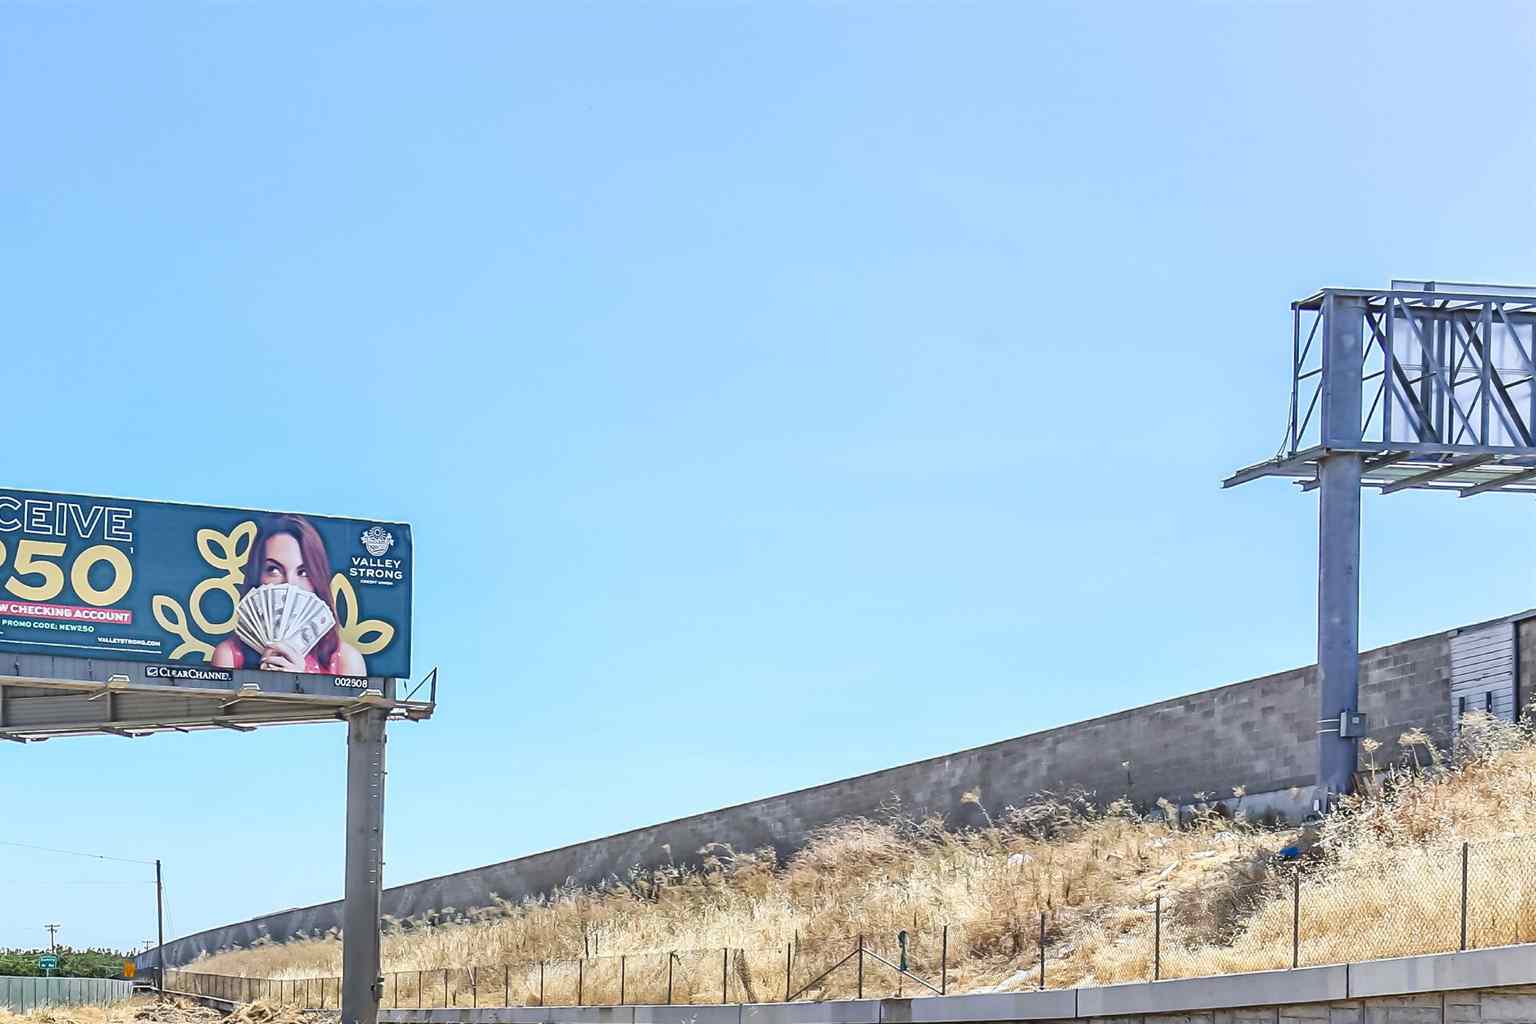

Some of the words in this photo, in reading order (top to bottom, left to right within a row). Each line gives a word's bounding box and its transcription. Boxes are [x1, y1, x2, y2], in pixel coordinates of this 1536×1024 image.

[352, 557, 401, 569] VALLEY
[349, 567, 403, 580] STRONG
[10, 604, 73, 618] CHECKING
[73, 609, 130, 622] ACCOUNT
[2, 619, 32, 628] PROMO
[59, 624, 95, 633] NEW250
[334, 677, 368, 688] 002508
